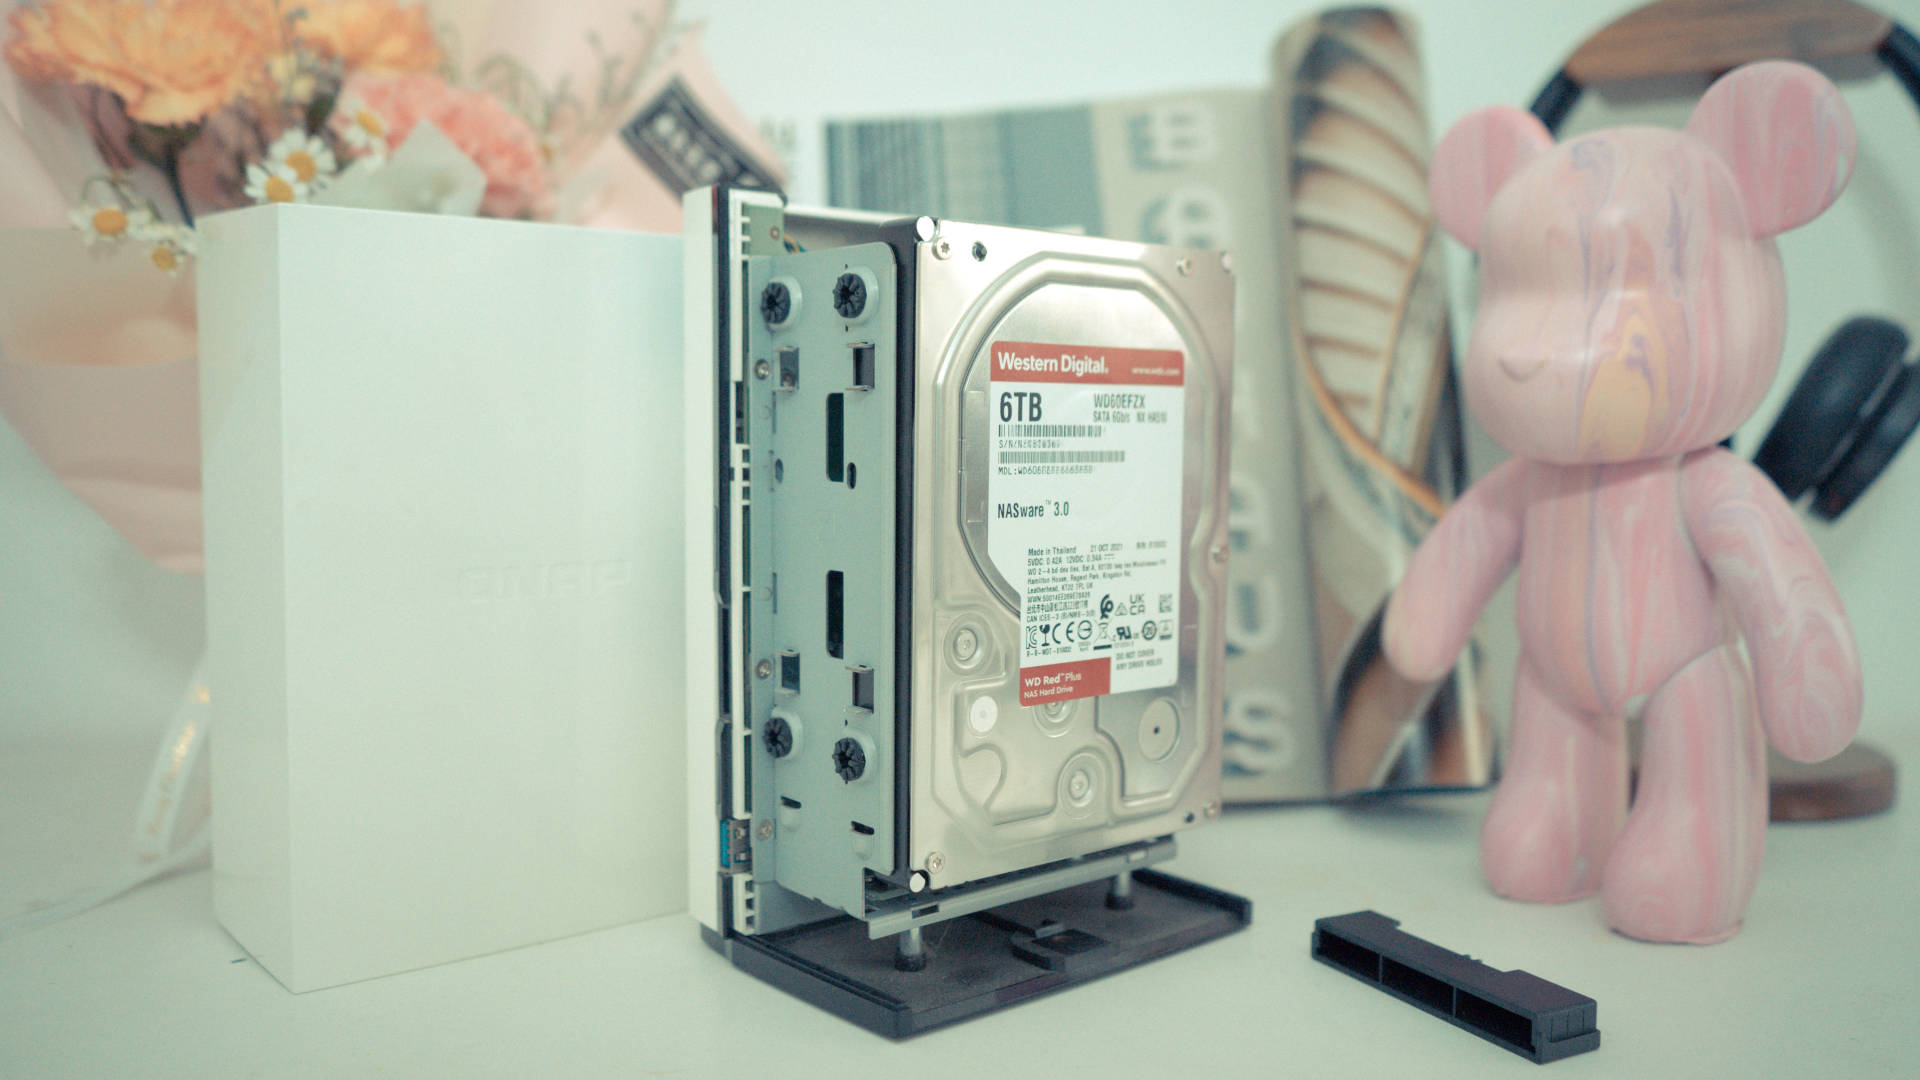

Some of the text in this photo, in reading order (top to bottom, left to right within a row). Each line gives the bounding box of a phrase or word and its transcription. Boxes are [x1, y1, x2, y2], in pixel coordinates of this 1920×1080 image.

[998, 351, 1058, 372] Western
[1000, 391, 1042, 422] 6TB
[1094, 393, 1146, 409] WD60EFZX
[1093, 410, 1110, 423] SATA
[1054, 501, 1070, 517] 3.0
[1028, 548, 1044, 557] Made
[1053, 546, 1077, 556] Thailand
[1025, 677, 1041, 688] WD
[1065, 672, 1082, 682] Plus
[1024, 685, 1073, 699] NAS Hard Drive
